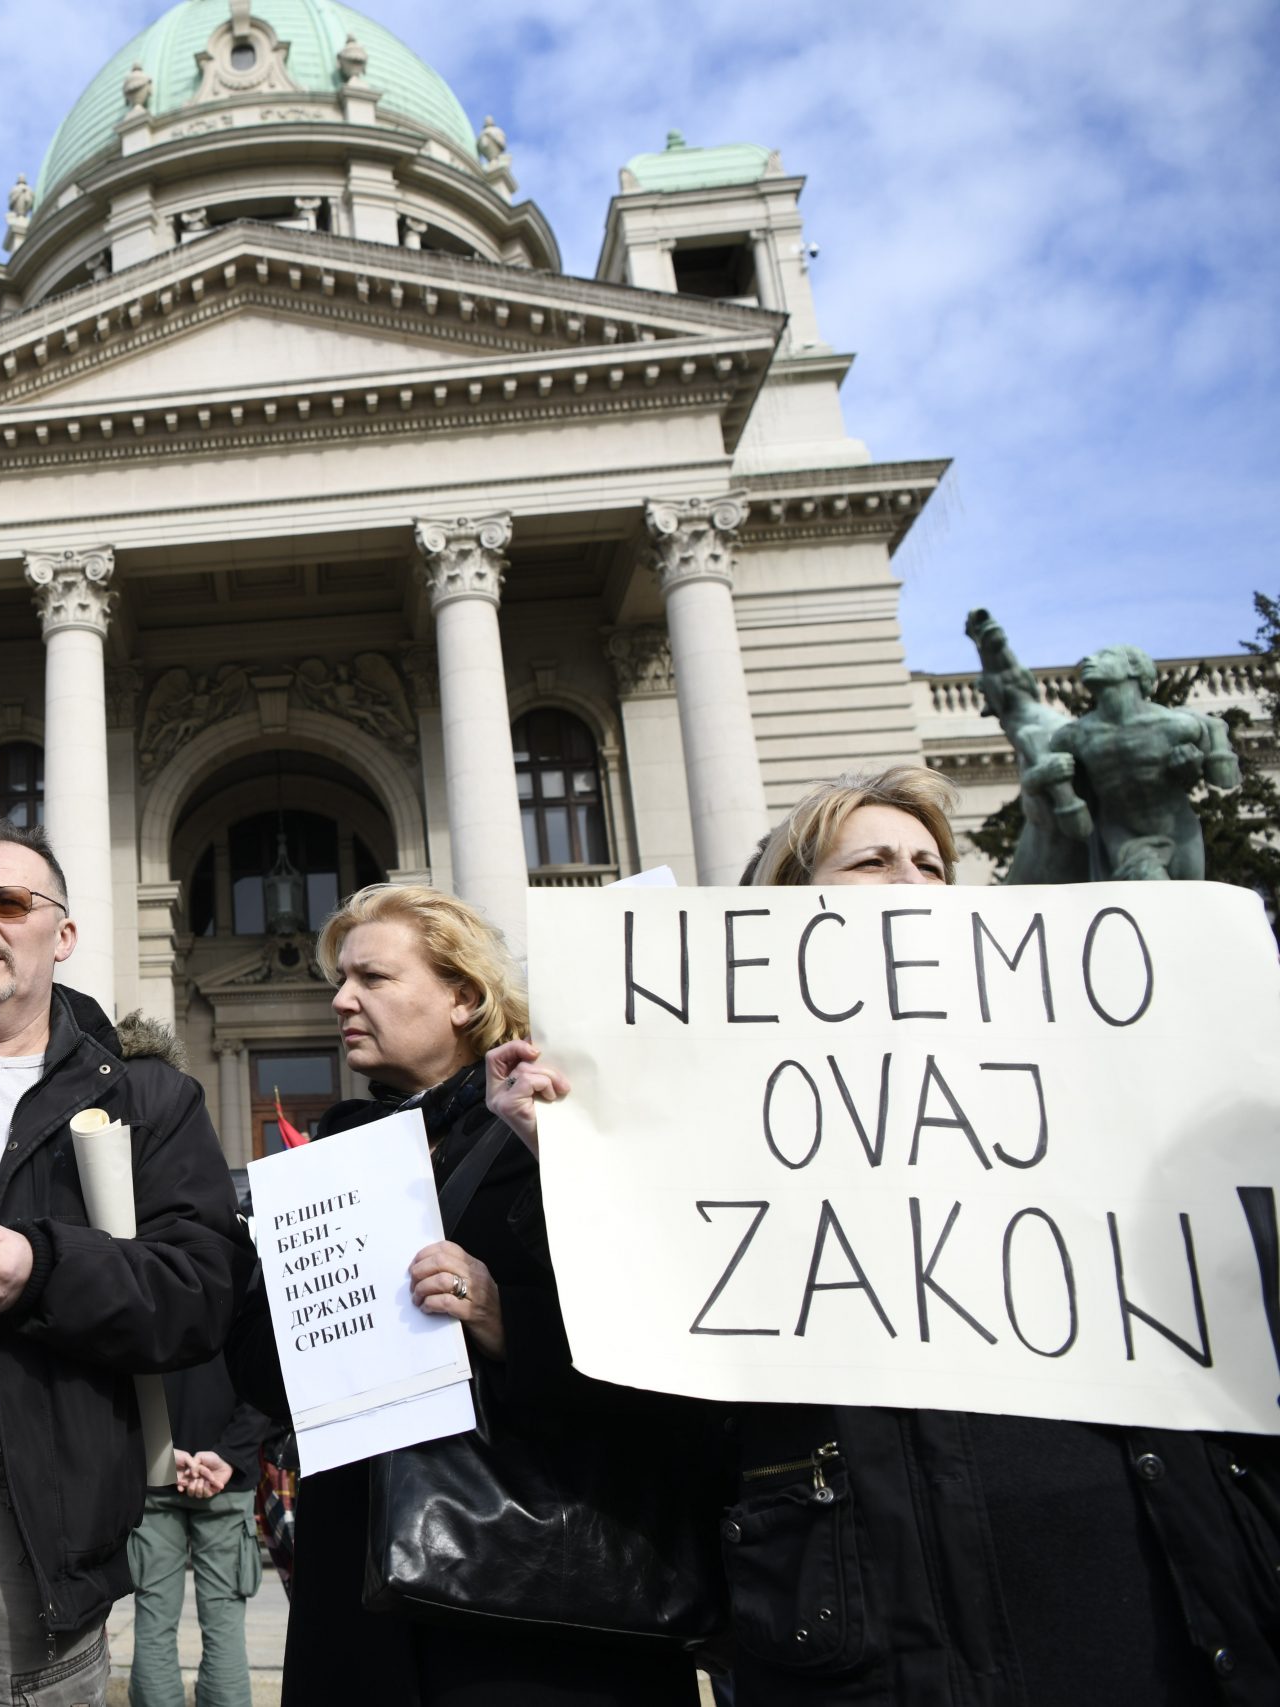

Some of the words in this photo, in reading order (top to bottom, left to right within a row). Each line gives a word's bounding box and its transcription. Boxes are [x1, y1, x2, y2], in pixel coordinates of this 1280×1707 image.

[624, 895, 1155, 1027] NEĆEMO
[762, 1053, 1048, 1170] OVAJ
[274, 1189, 361, 1231] РЕШИТЕ
[277, 1223, 329, 1254] БЕБИ
[282, 1240, 348, 1278] АФЕРУ
[355, 1234, 368, 1252] У
[286, 1263, 360, 1302] НАШОЈ
[291, 1284, 377, 1330] ДРЖАВИ
[295, 1312, 375, 1352] СРБИЈИ
